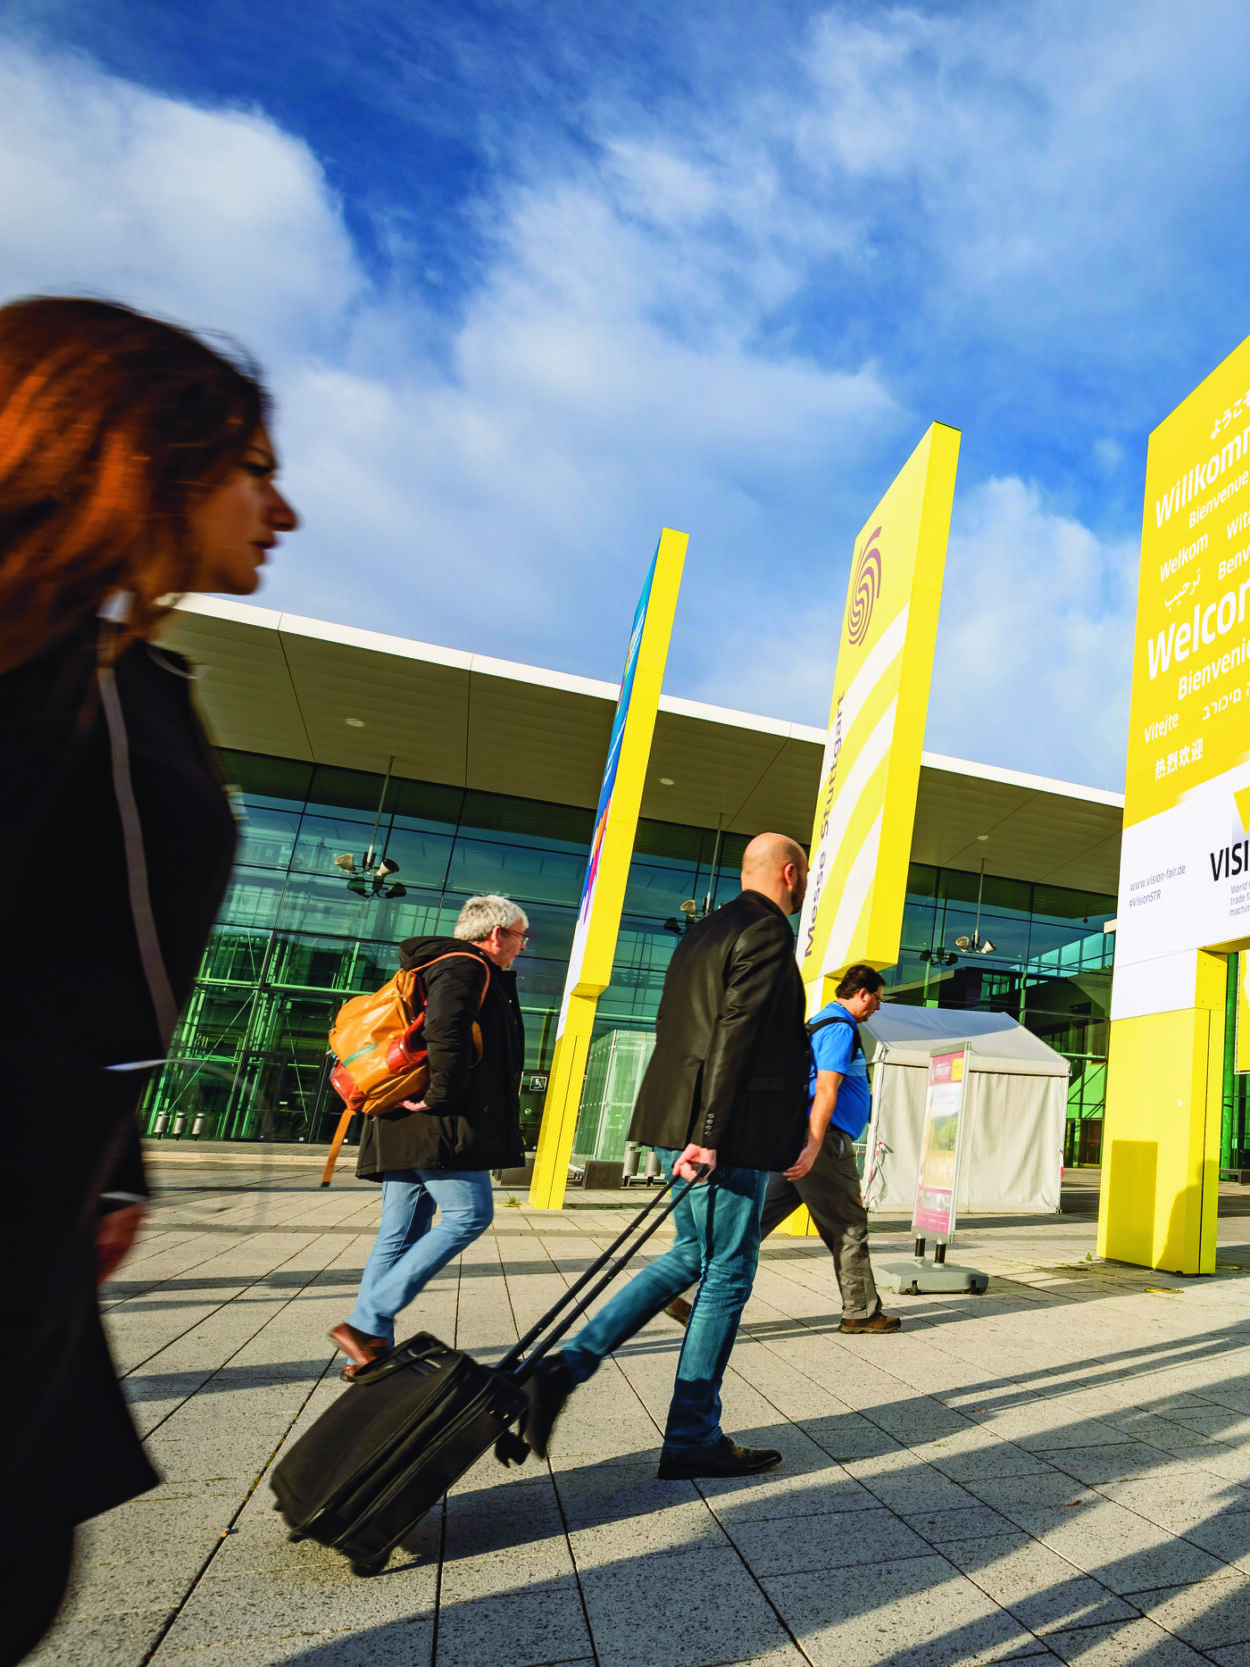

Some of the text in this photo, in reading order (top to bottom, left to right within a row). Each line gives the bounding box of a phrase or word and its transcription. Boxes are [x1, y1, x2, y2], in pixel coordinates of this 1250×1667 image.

[1189, 470, 1249, 528] Bienvenue
[1160, 534, 1208, 582] Welkom
[805, 691, 844, 957] Messe Stuttgart
[1129, 864, 1186, 892] www.vision-fair.de
[1128, 889, 1162, 908] #VisionSTR
[1230, 894, 1246, 906] trade
